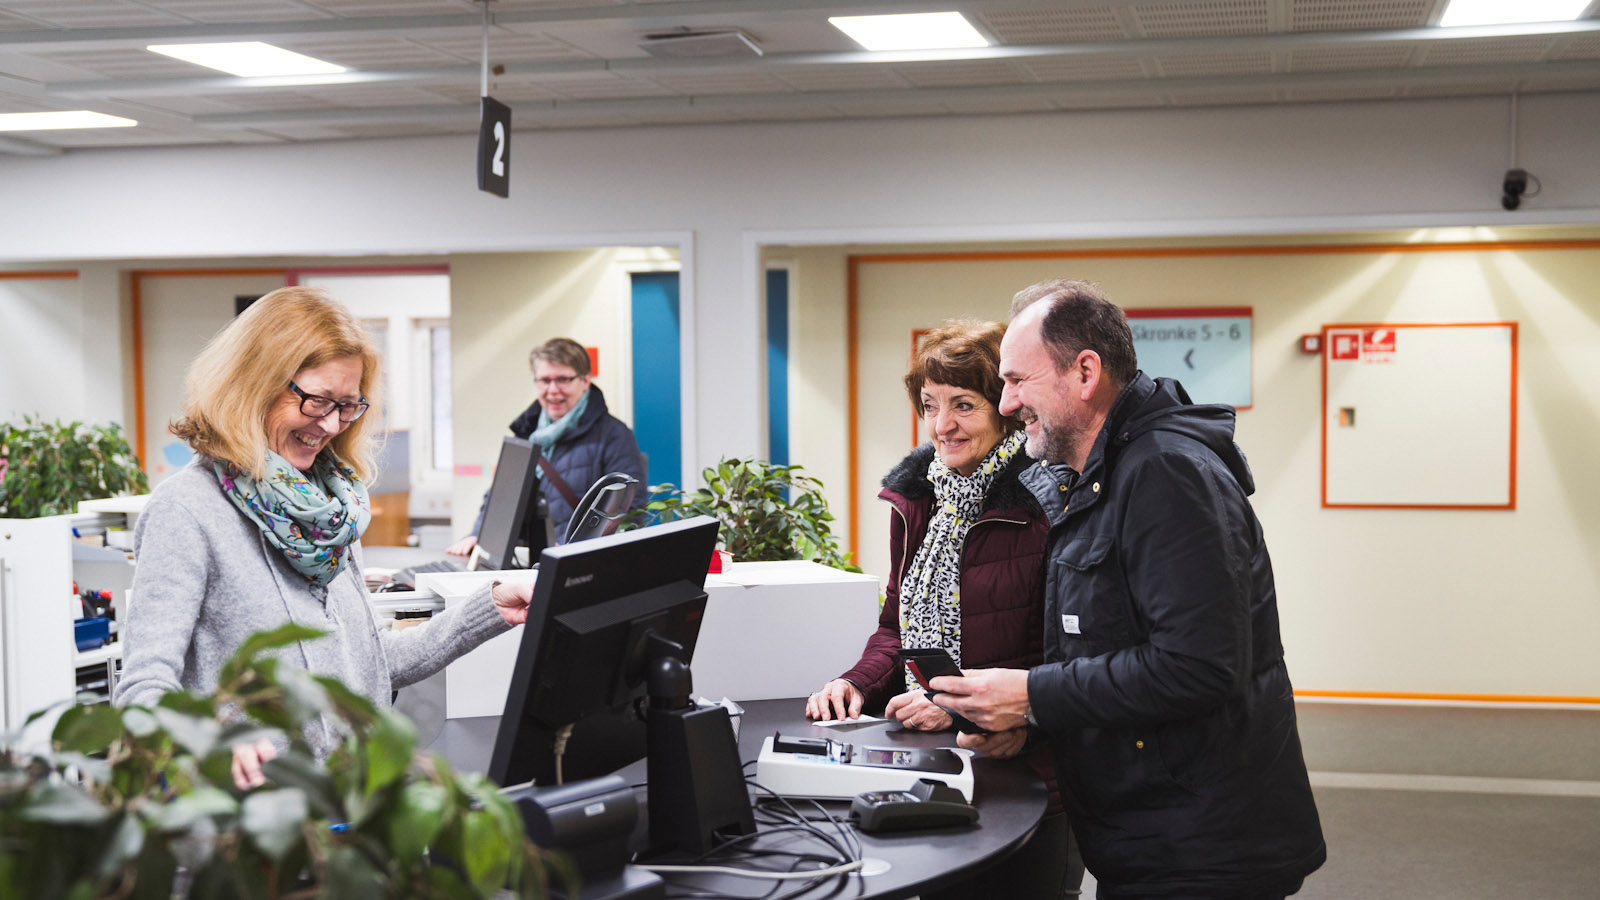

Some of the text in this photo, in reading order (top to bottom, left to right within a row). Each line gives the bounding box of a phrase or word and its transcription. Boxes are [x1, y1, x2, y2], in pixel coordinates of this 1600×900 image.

[492, 121, 505, 177] 2
[1132, 324, 1198, 341] Skranke
[1201, 323, 1212, 341] 5
[1229, 323, 1242, 341] 6
